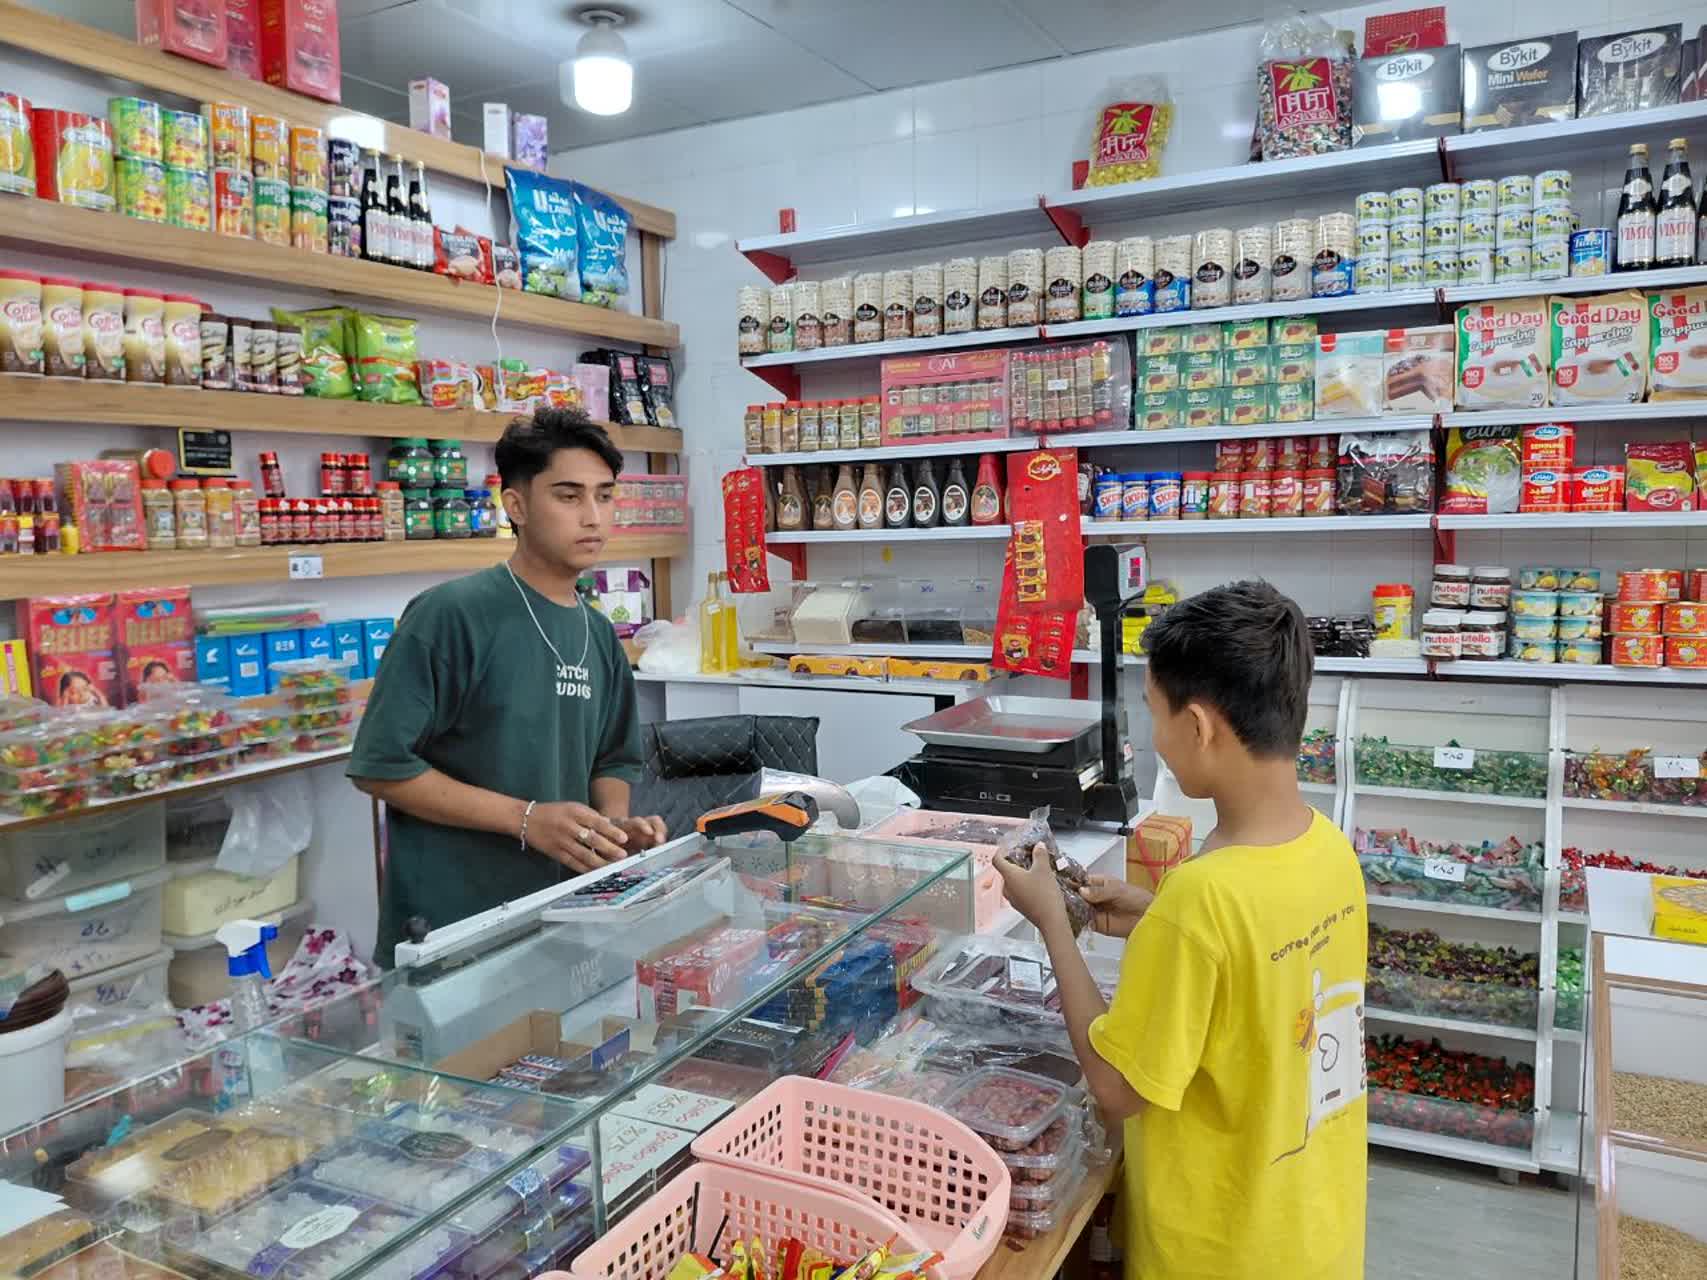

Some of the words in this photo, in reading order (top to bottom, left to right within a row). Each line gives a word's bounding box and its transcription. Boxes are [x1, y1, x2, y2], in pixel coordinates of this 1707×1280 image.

[1611, 37, 1652, 58] Bykit
[1499, 47, 1538, 67] Bykit
[1386, 58, 1424, 77] Bykit
[1487, 71, 1514, 85] Mini
[1515, 69, 1549, 82] Wafer
[1556, 309, 1602, 325] Good
[1605, 307, 1642, 325] Day
[1652, 301, 1701, 318] Good
[1462, 313, 1507, 332] Good
[1511, 310, 1544, 328] Day
[1434, 584, 1468, 593] nutella
[1461, 632, 1491, 644] utella
